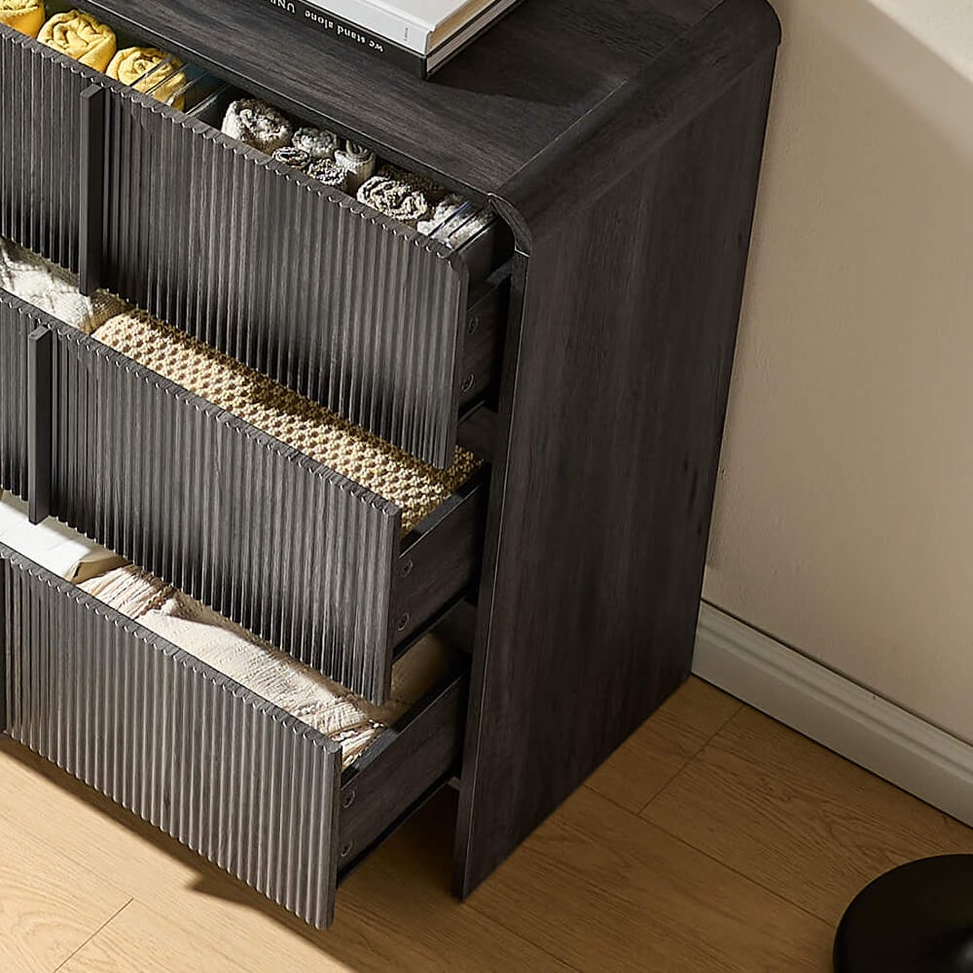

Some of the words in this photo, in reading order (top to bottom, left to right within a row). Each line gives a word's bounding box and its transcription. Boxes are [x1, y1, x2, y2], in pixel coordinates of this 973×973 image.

[304, 10, 334, 29] alone
[336, 25, 366, 44] stand
[368, 40, 385, 53] we
